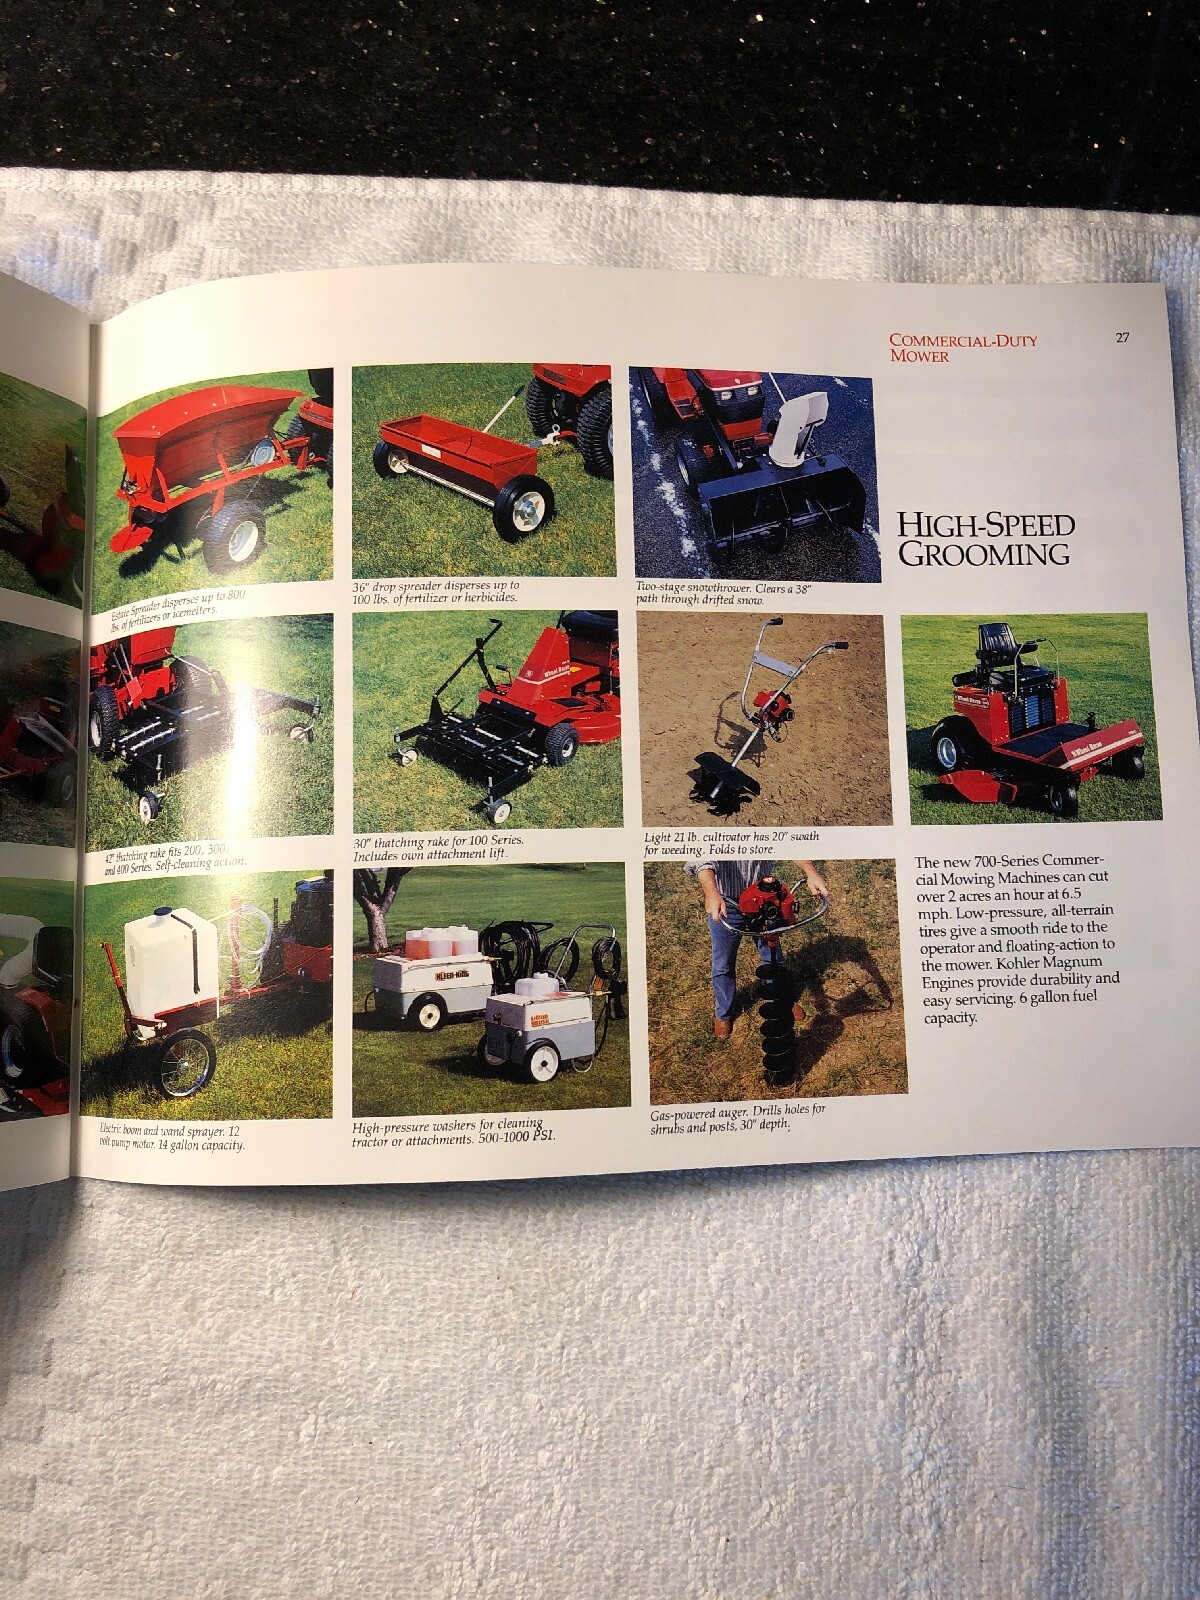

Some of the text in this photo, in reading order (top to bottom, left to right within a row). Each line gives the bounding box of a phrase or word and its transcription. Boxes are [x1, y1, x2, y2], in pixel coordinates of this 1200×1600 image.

[889, 333, 1038, 348] COMMERCIAL-DUTY
[1116, 332, 1130, 343] 27
[890, 350, 950, 363] MOWER
[896, 511, 1076, 537] HIGH-SPEED
[898, 540, 1071, 566] GROOMING
[352, 580, 520, 594] 36" drop spreader disperses up to
[636, 581, 812, 595] Two-stage snowthrower. Clears a 38"
[111, 589, 246, 621] Estate Spreader disperses up to 800
[353, 592, 517, 607] 100 lbs. of fertilizer or herbicides.
[636, 594, 764, 607] path through drifted snow.
[121, 620, 128, 632] of
[128, 613, 160, 631] fertilizers
[162, 611, 170, 620] or
[172, 606, 218, 618] icemelters.
[353, 834, 524, 851] 30" thatching rake for 100 Series.
[644, 831, 820, 845] Light 21 lb. cultivator has 20" swath
[116, 850, 148, 863] thatching
[149, 848, 166, 859] rake
[168, 847, 182, 860] fits
[184, 845, 204, 857] 200,
[353, 847, 508, 862] Includes own attachment lift.
[644, 844, 776, 858] for weeding. Folds to store.
[104, 857, 247, 876] and 400 Series. Self-cleaning action.
[914, 853, 1105, 869] The new 700-Series Commer-
[915, 870, 1109, 888] cial Mowing Machines can cut
[916, 888, 1082, 903] over 2 acres an hour at 6.5
[917, 904, 1114, 923] mph. Low-pressure, all-terrain
[919, 921, 1108, 940] tires give a smooth ride to the
[920, 938, 1115, 958] operator and floating-action to
[921, 956, 1103, 972] the mower. Kohler Magnum
[922, 971, 1120, 992] Engines provide durability and
[923, 989, 1098, 1010] easy servicing. 6 gallon fuel
[924, 1012, 978, 1028] capacity.
[650, 1103, 826, 1124] Gas-powered auger. Drills holes for
[100, 1122, 240, 1140] Electric boom and wand sprayer. 12
[352, 1117, 543, 1137] High-pressure washers for cleaning
[650, 1122, 684, 1136] shrubs
[686, 1121, 706, 1133] and
[709, 1121, 738, 1135] posts,
[739, 1119, 757, 1131] 30"
[99, 1136, 245, 1153] volt pump motor. 14 gallon capacity.
[351, 1130, 556, 1147] tractor or attachments. 500-1000 PSI.
